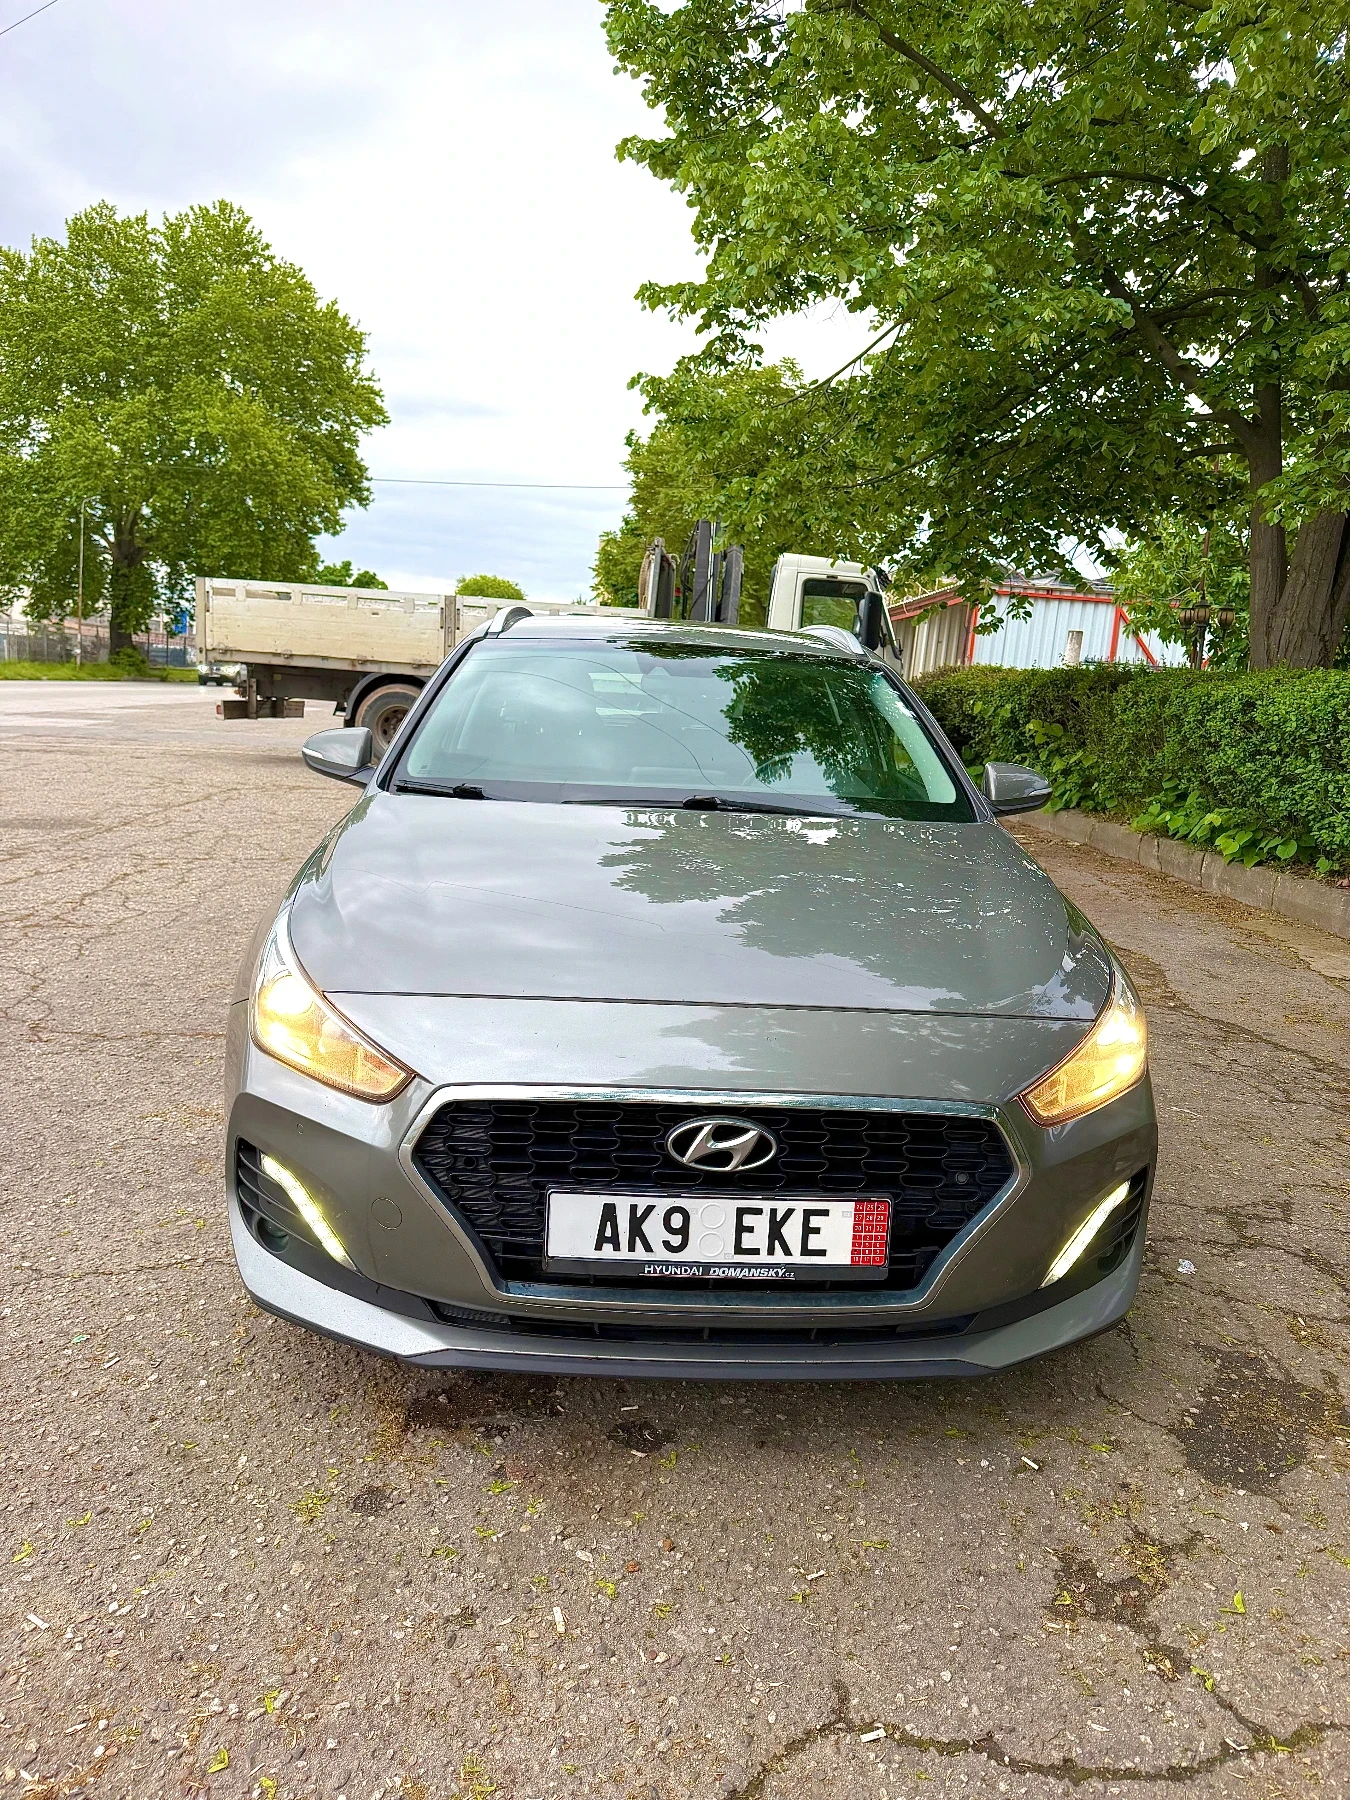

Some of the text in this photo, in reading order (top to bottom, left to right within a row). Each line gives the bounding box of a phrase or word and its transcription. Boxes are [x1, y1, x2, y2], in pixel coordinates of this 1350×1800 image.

[593, 1202, 830, 1257] AK9 EKE
[644, 1264, 703, 1276] HYUNDAI
